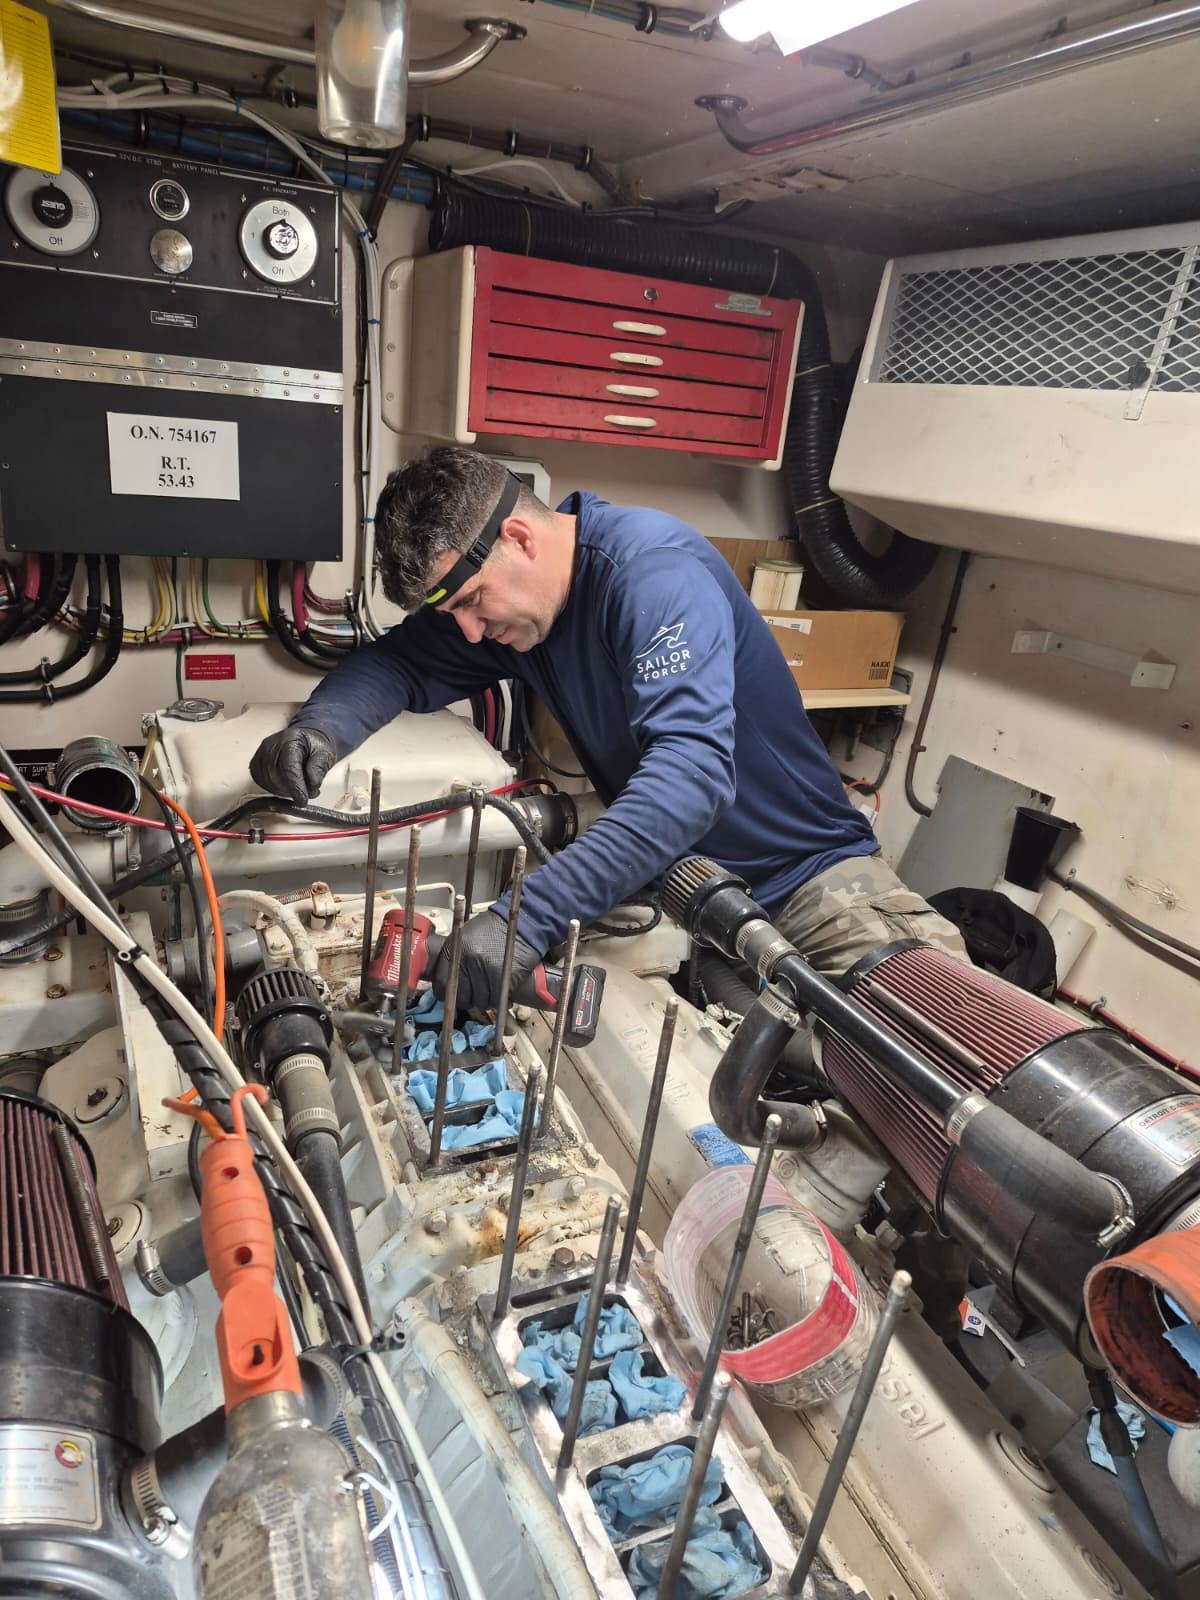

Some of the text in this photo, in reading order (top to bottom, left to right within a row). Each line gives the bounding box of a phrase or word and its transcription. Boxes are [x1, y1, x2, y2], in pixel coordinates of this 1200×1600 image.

[272, 206, 290, 217] Both
[48, 236, 63, 246] Off
[271, 266, 284, 276] Off
[130, 424, 217, 444] O.N. 754167
[161, 456, 191, 471] R.T.
[158, 473, 195, 488] 53.43
[636, 649, 691, 673] SAILOR
[643, 662, 688, 683] FORCE
[386, 931, 402, 982] Milwaukee
